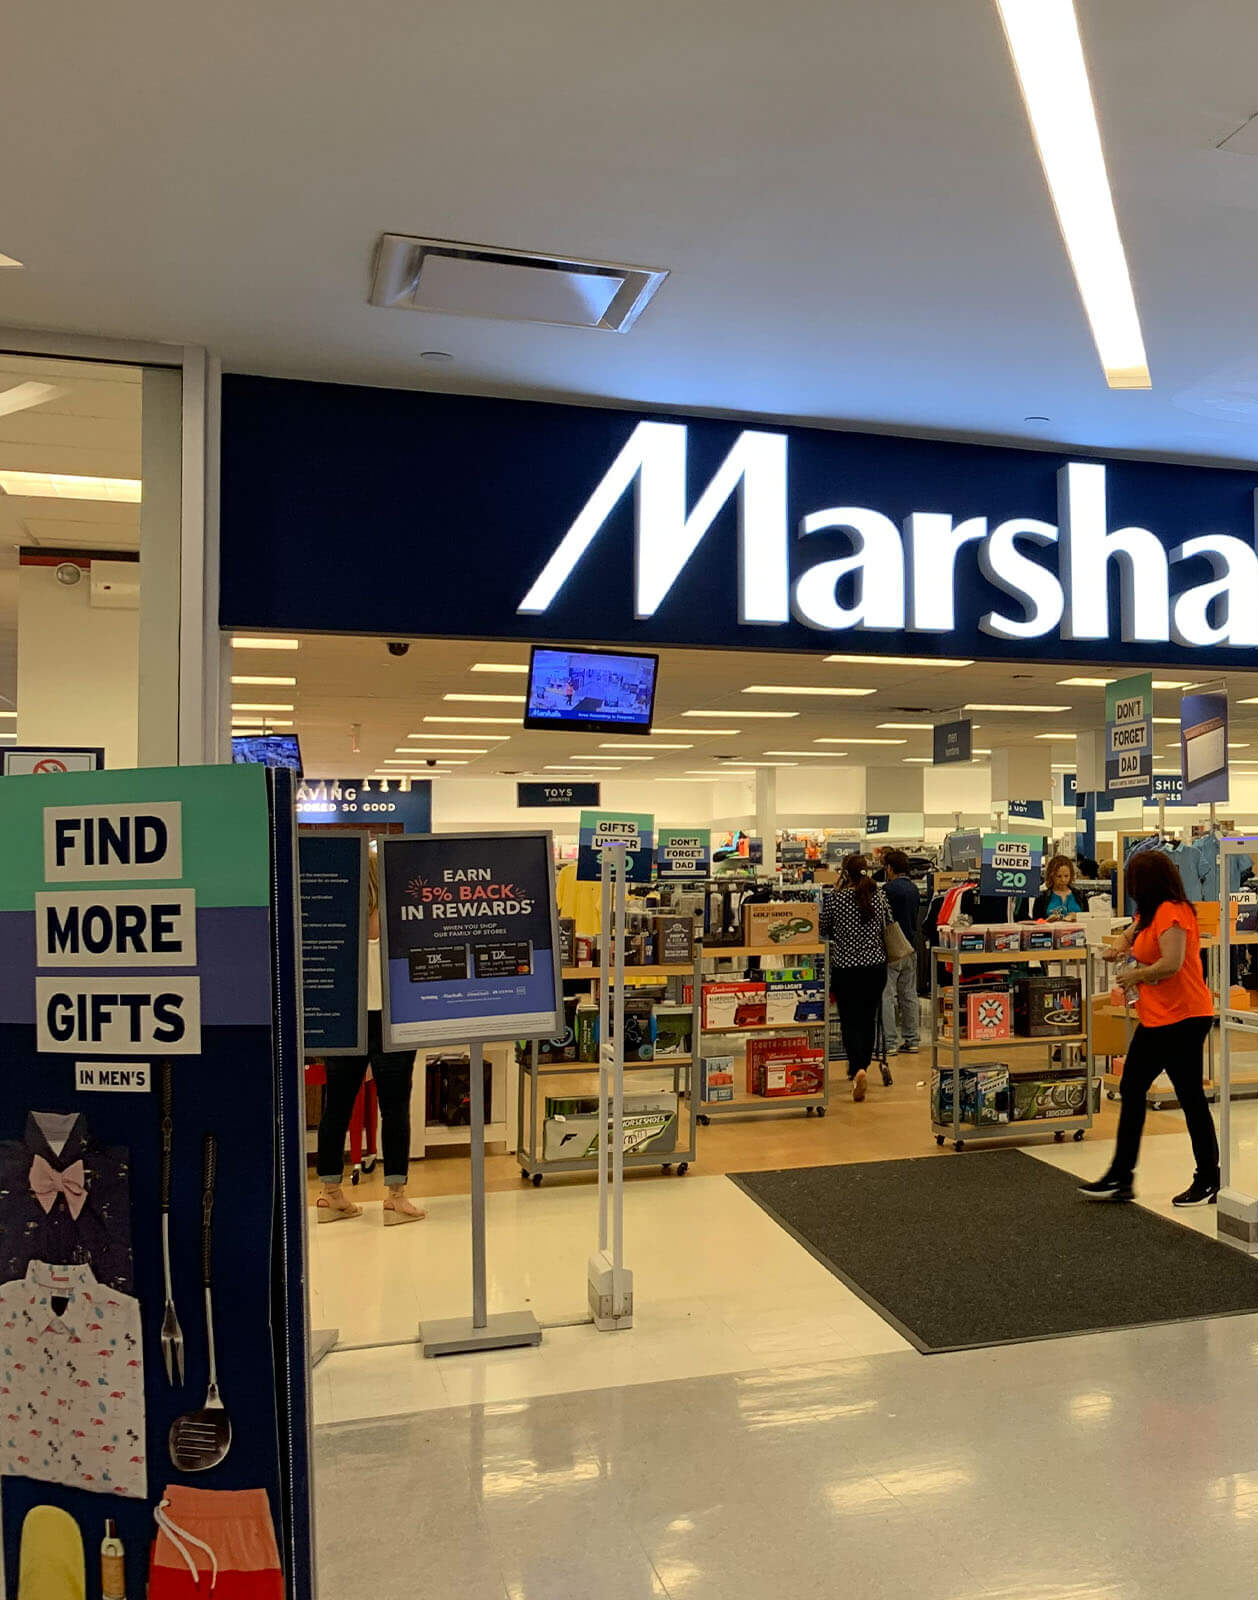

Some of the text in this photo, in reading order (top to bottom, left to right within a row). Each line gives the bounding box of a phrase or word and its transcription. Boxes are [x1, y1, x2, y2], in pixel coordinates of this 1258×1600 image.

[1117, 701, 1141, 719] DON'T
[1113, 727, 1145, 746] FORGET
[1121, 756, 1138, 772] DAD
[296, 788, 357, 801] AVING
[544, 788, 573, 797] TOYS
[342, 803, 358, 812] SO
[362, 803, 396, 812] GOOD
[599, 822, 636, 833] GIFTS
[55, 815, 168, 867] FIND
[670, 838, 699, 846] DON'T
[998, 843, 1027, 853] GIFTS
[666, 849, 702, 858] FORGET
[674, 861, 694, 869] DAD
[995, 857, 1030, 867] UNDER
[443, 868, 492, 882] EARN
[996, 870, 1027, 888] $20
[421, 883, 516, 903] 5% BACK
[401, 904, 424, 921] IN
[46, 904, 183, 955] MORE
[46, 993, 186, 1044] GIFTS
[79, 1069, 146, 1087] IN MEN'S
